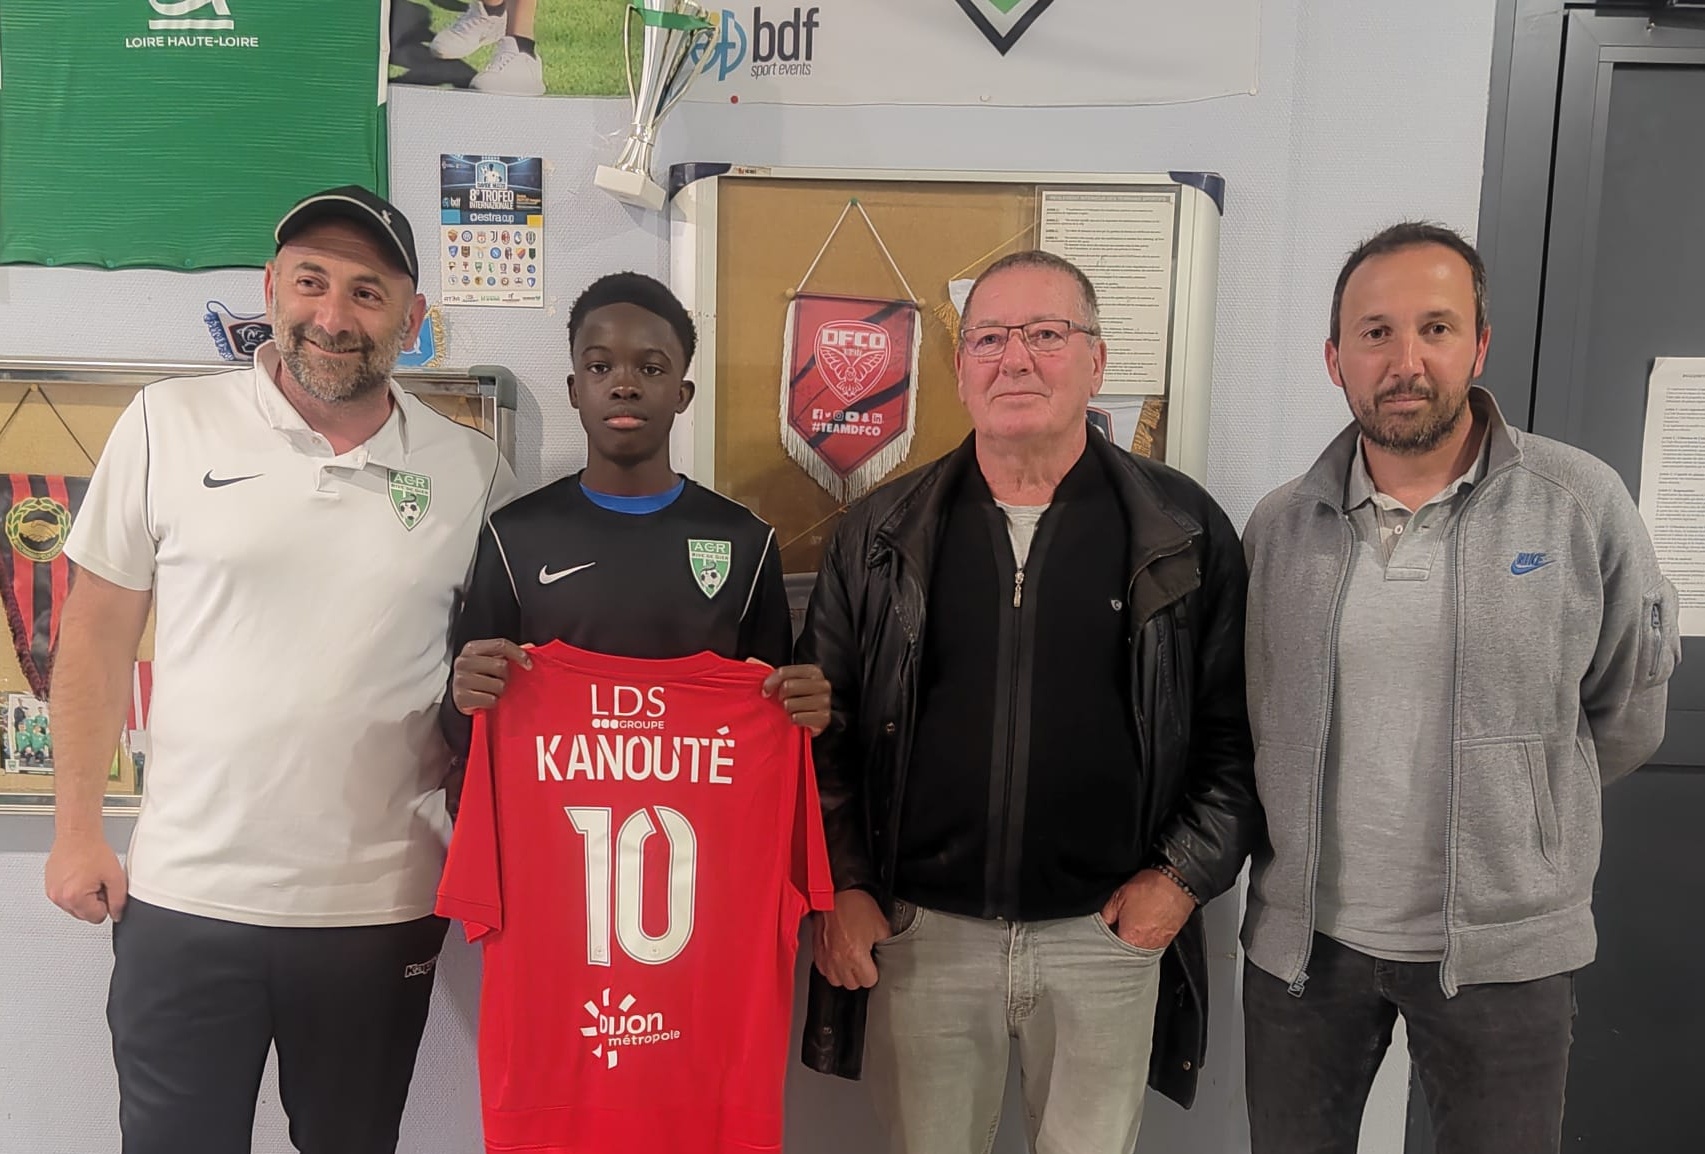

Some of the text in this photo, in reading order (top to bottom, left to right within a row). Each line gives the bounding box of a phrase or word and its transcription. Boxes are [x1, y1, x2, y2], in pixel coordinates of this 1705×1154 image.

[125, 36, 259, 48] LOIRE HAUTE-LOIRE
[752, 6, 819, 62] bdf
[751, 62, 812, 80] sport events
[481, 189, 514, 202] TROFEO
[821, 328, 886, 349] DFCO
[812, 423, 881, 436] #TEAMDFCO
[591, 684, 666, 717] LDS
[619, 720, 665, 729] GROUPE
[536, 725, 735, 784] KANOUTÉ
[563, 805, 697, 967] 10
[608, 1029, 680, 1047] métropole
